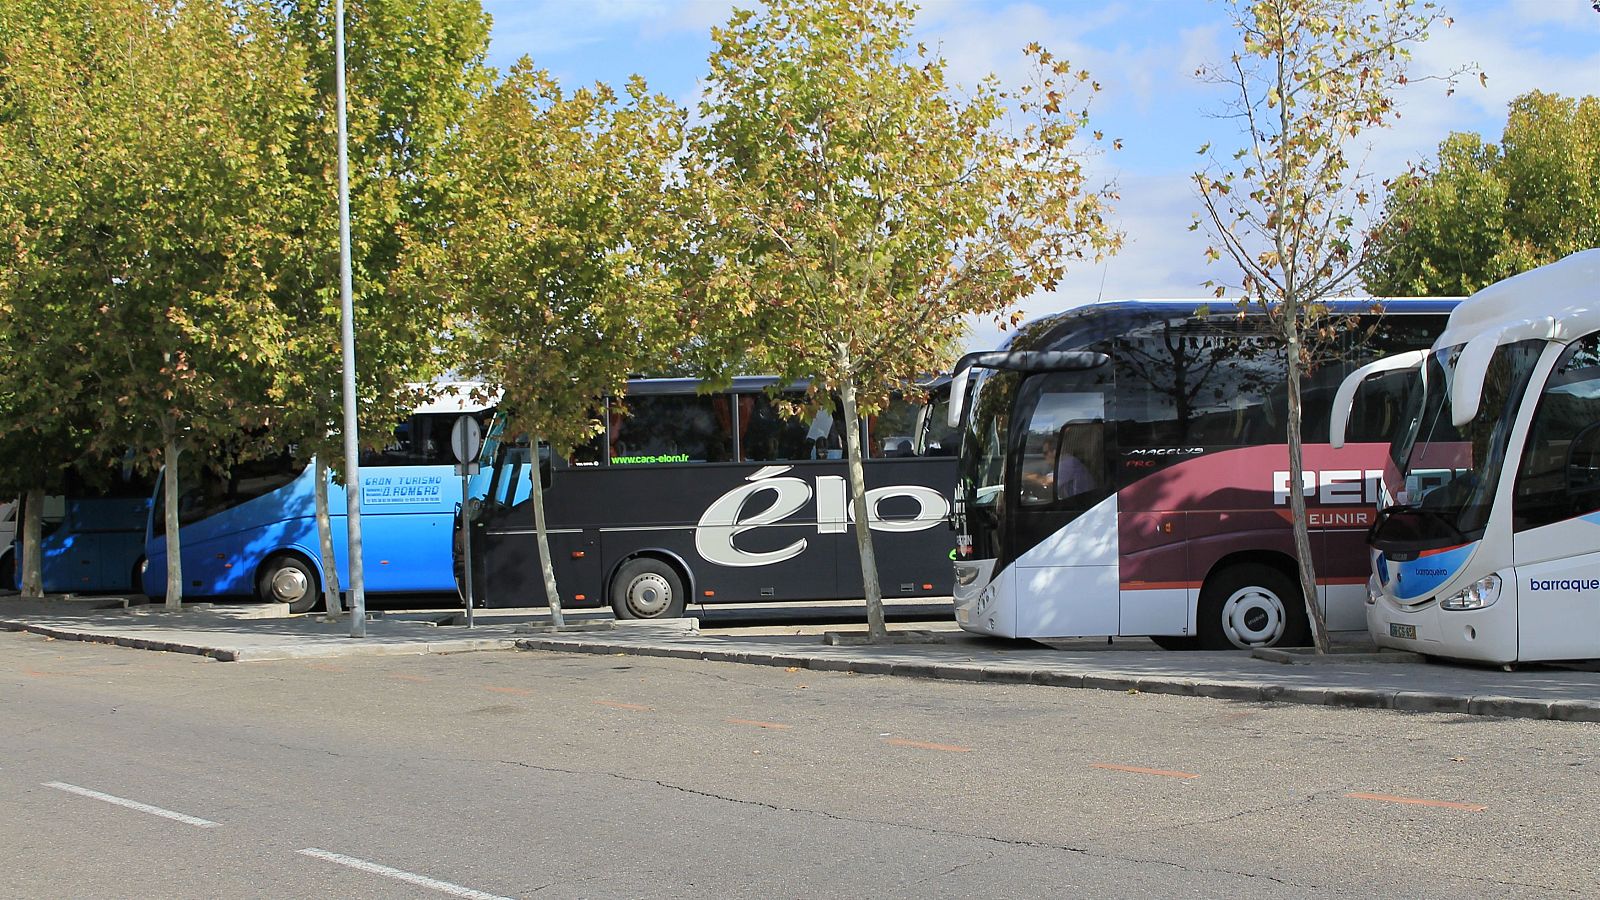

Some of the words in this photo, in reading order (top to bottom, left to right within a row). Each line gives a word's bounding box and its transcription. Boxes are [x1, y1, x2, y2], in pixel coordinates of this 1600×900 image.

[611, 454, 689, 465] www.cars-elorn.fr
[1126, 460, 1155, 468] PRO
[365, 477, 392, 486] GRAN
[399, 476, 442, 485] TURISMO
[1415, 568, 1448, 578] barraqueiro
[1530, 578, 1600, 593] barraque
